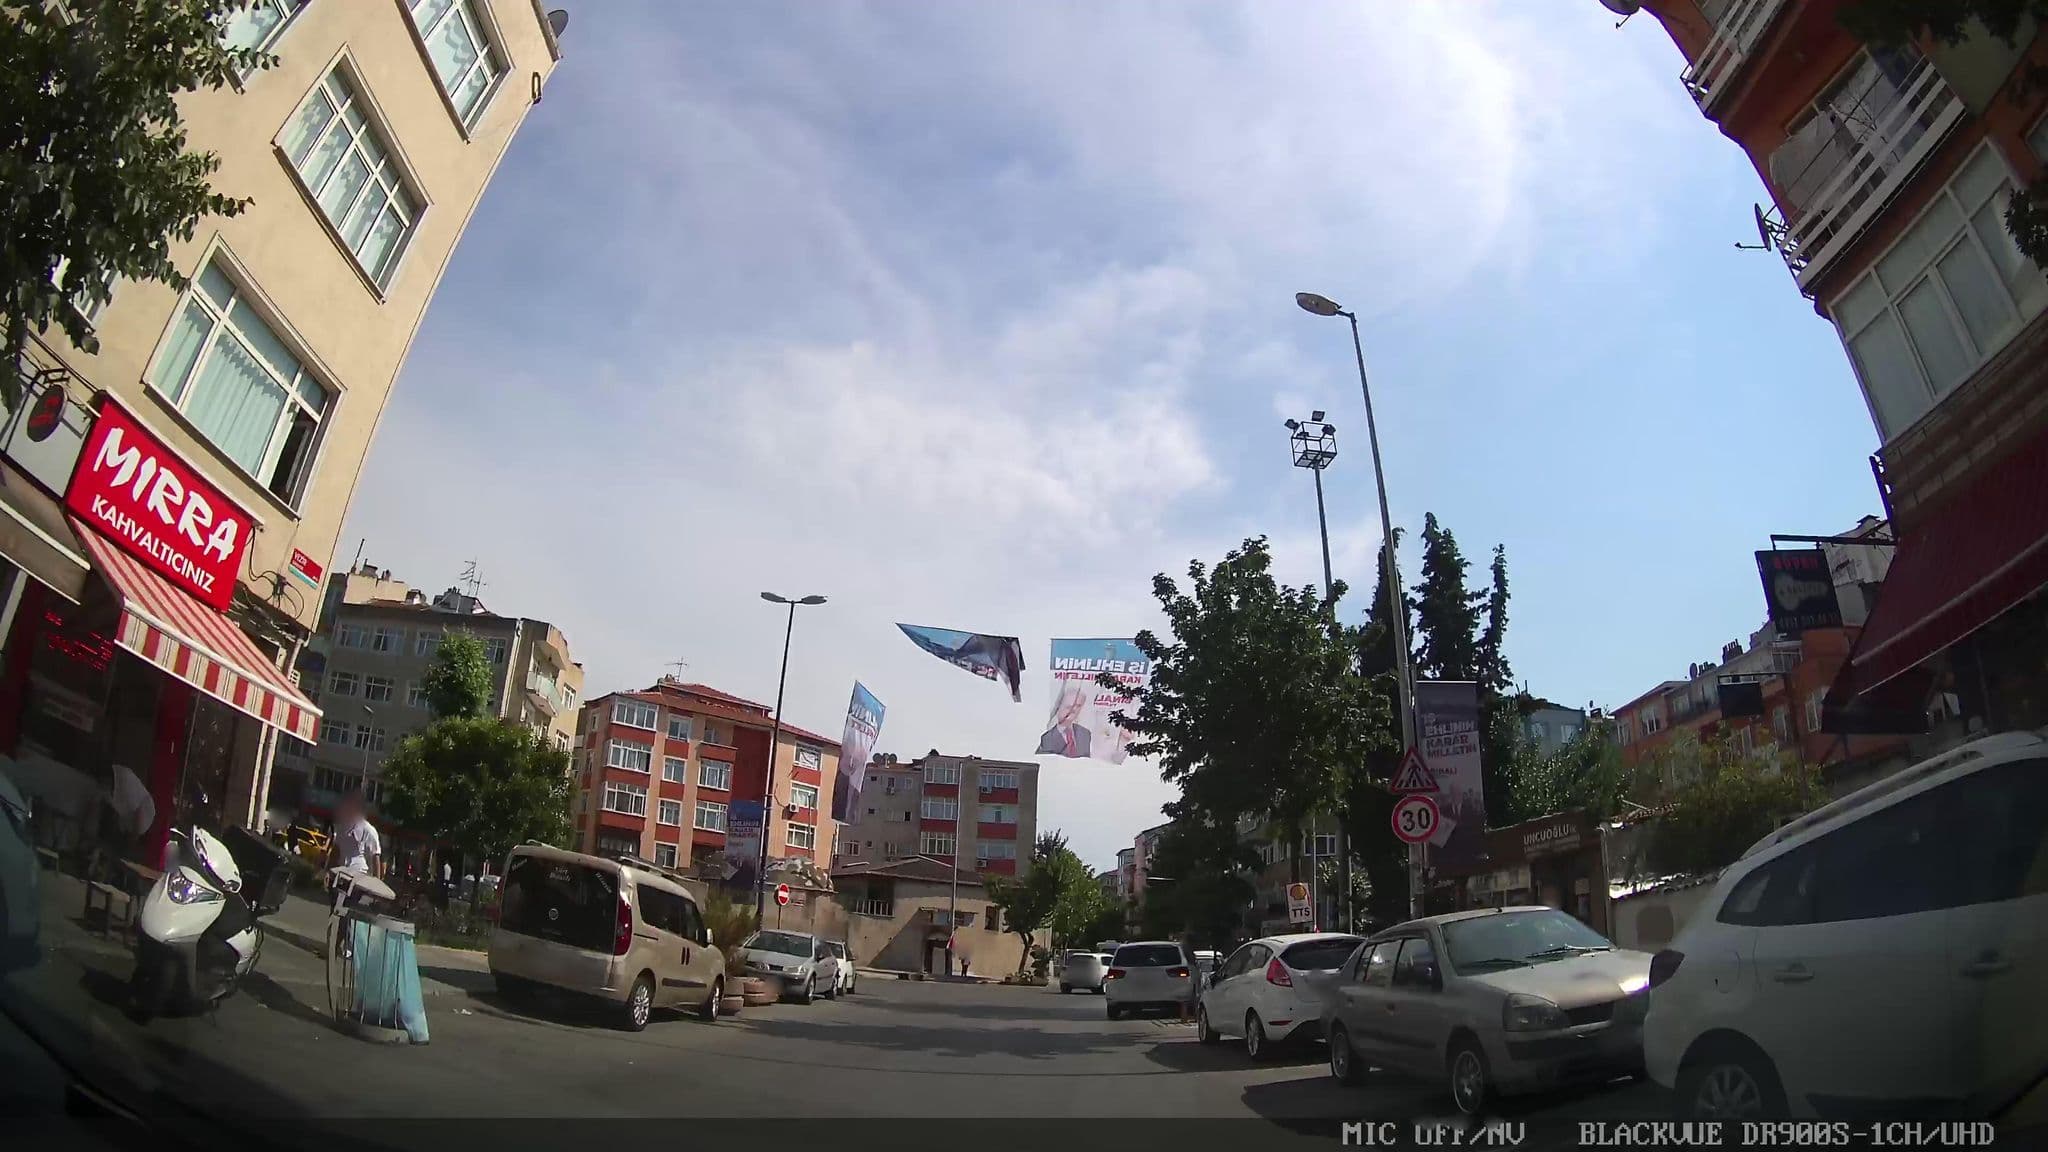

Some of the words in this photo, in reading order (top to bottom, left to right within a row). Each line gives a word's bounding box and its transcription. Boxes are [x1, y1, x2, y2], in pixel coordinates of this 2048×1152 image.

[93, 427, 240, 563] MIRRA
[91, 494, 217, 594] KAHVALTICINIZ
[1402, 807, 1431, 832] 30
[1292, 908, 1310, 917] TTS
